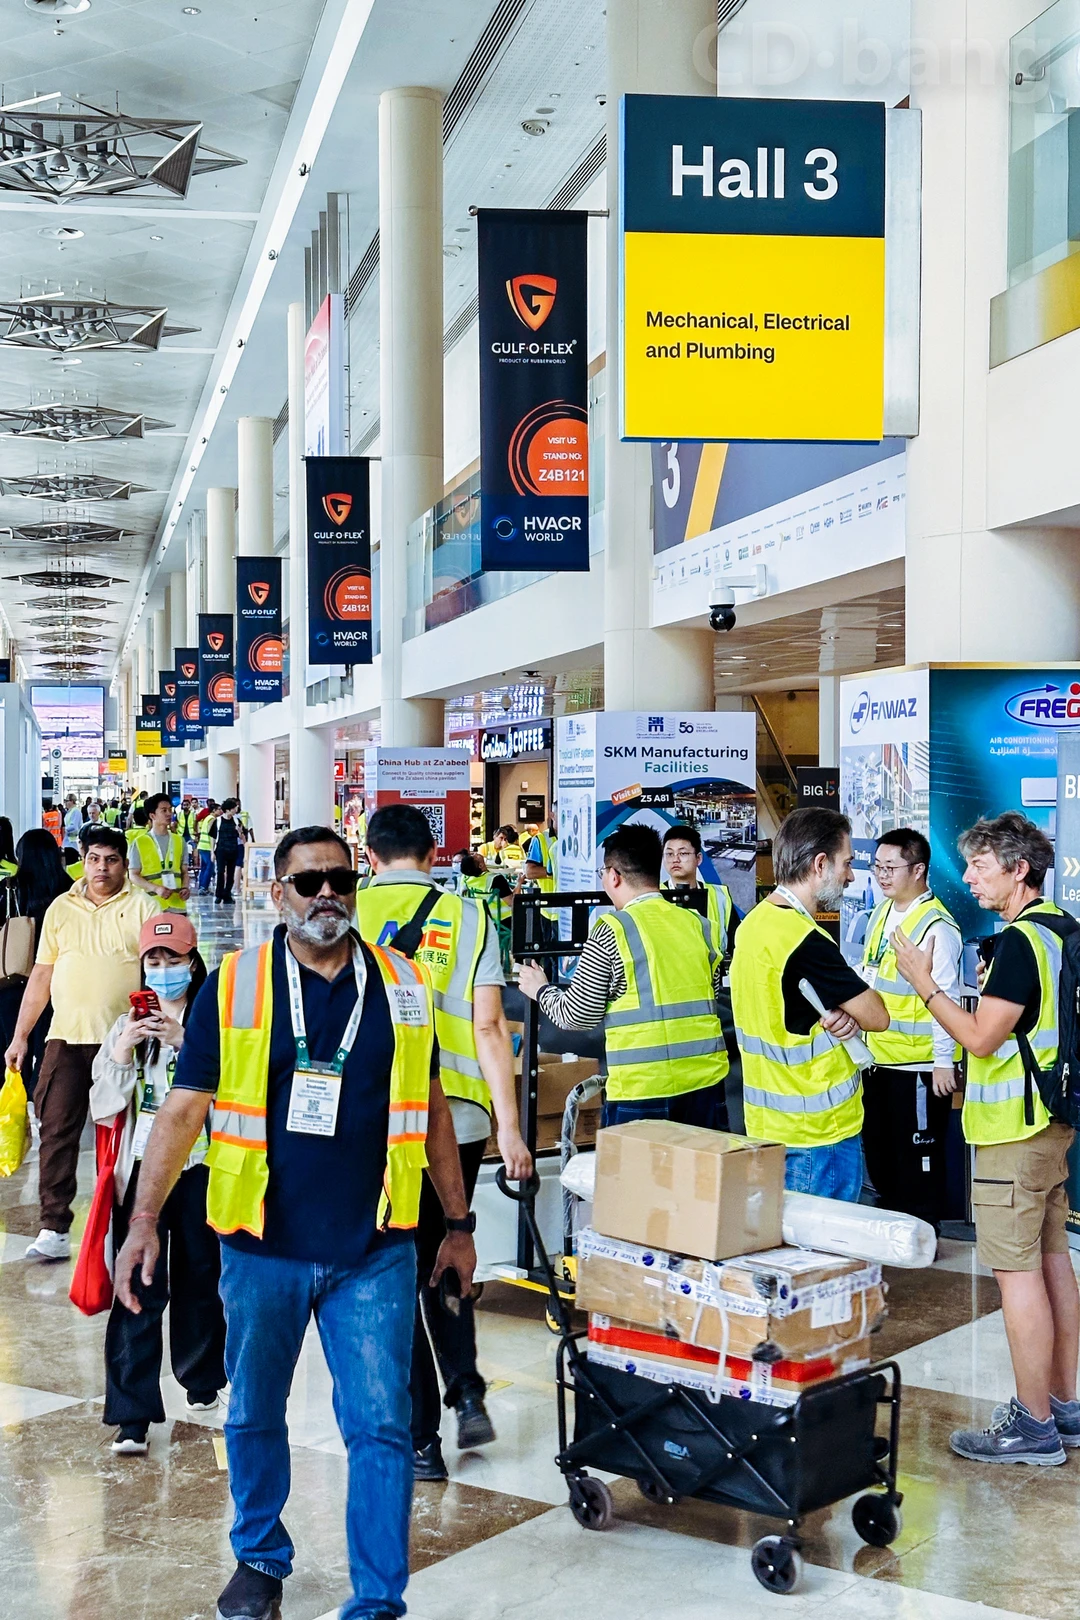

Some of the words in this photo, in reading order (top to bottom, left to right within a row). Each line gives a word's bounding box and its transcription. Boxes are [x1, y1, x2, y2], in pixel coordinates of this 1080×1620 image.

[671, 145, 785, 199] Hall
[803, 147, 838, 200] 3
[645, 311, 759, 332] Mechanical,
[763, 313, 850, 331] Electrical
[645, 342, 680, 359] and
[686, 343, 775, 364] Plumbing
[542, 452, 568, 460] STAND
[569, 452, 582, 460] NO:
[538, 469, 585, 482] Z4B121
[524, 516, 582, 530] HVACR
[524, 532, 564, 542] WORLD
[342, 604, 369, 612] Z4B121
[334, 632, 368, 640] HVACR
[871, 698, 916, 720] FAWAZ
[679, 722, 694, 733] 50
[514, 728, 544, 753] COFFEE
[604, 747, 636, 757] SKM
[642, 746, 748, 760] Manufacturing
[645, 761, 708, 773] Facilities
[613, 790, 631, 801] Visit
[632, 787, 641, 795] us
[803, 785, 823, 796] BIG
[654, 794, 669, 802] A81
[855, 850, 871, 863] Trading
